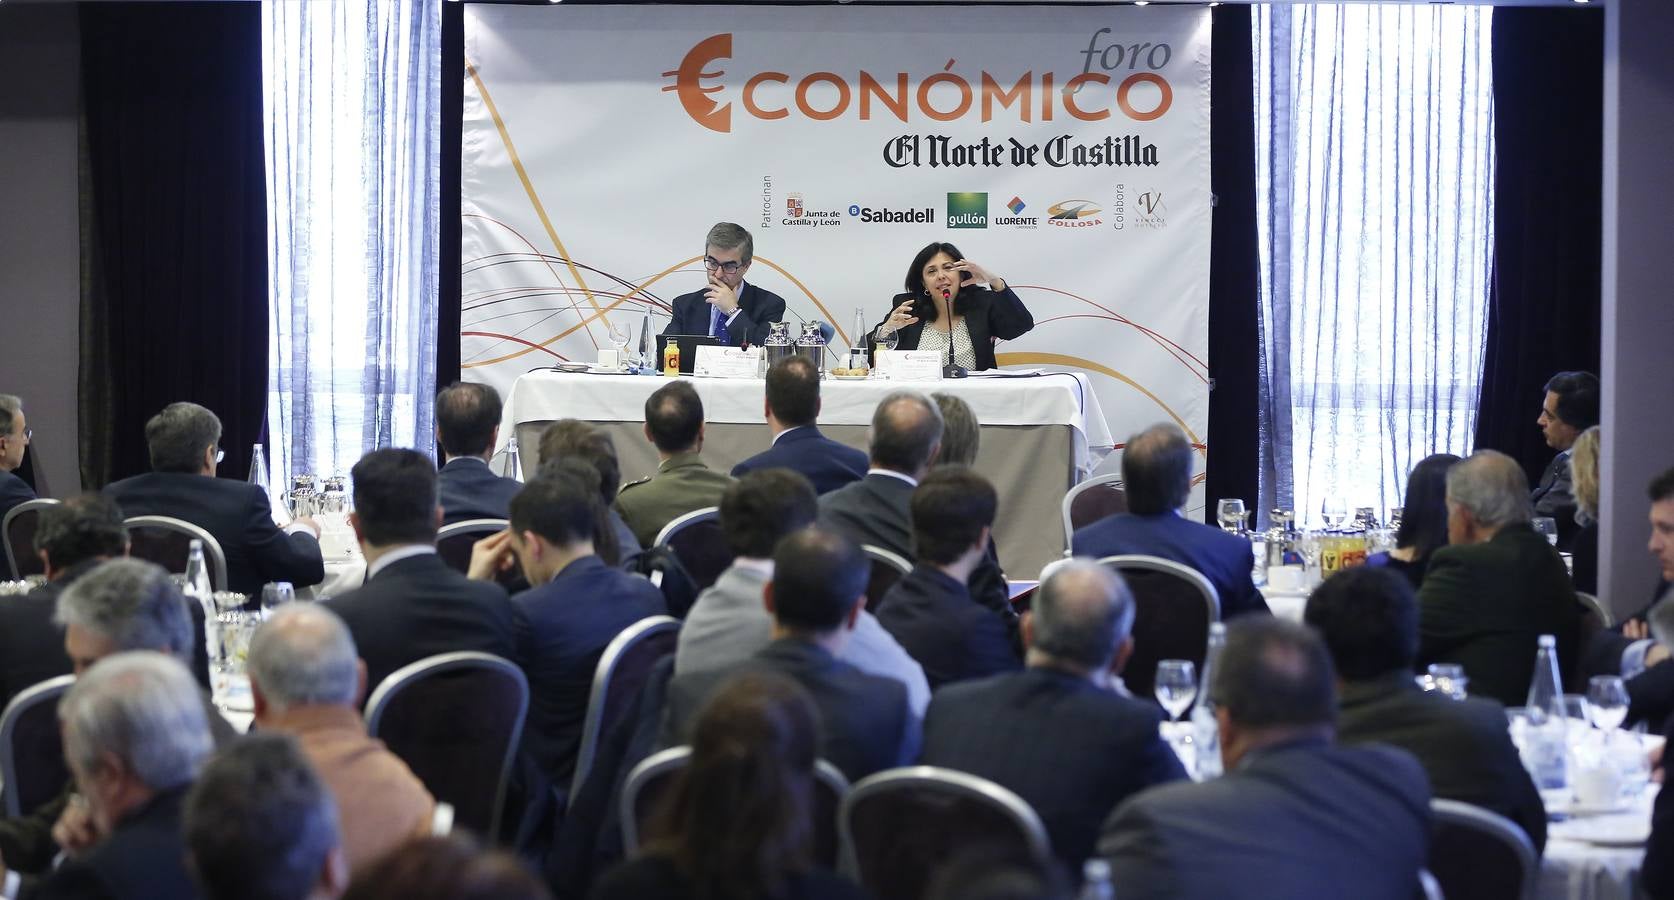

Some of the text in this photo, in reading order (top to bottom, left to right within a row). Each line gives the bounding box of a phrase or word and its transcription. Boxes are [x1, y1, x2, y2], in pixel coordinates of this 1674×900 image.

[1061, 27, 1172, 95] foro
[883, 134, 1161, 169] El Norte de Castilla
[761, 175, 772, 228] Patrocinan
[1113, 183, 1125, 231] Colabora
[804, 210, 841, 218] Junta de
[860, 207, 935, 223] Sabadell
[948, 212, 986, 226] gullón
[995, 217, 1038, 226] LLORENTE
[782, 218, 811, 226] Castilla
[820, 218, 841, 226] León
[1047, 218, 1103, 228] COLLOSA
